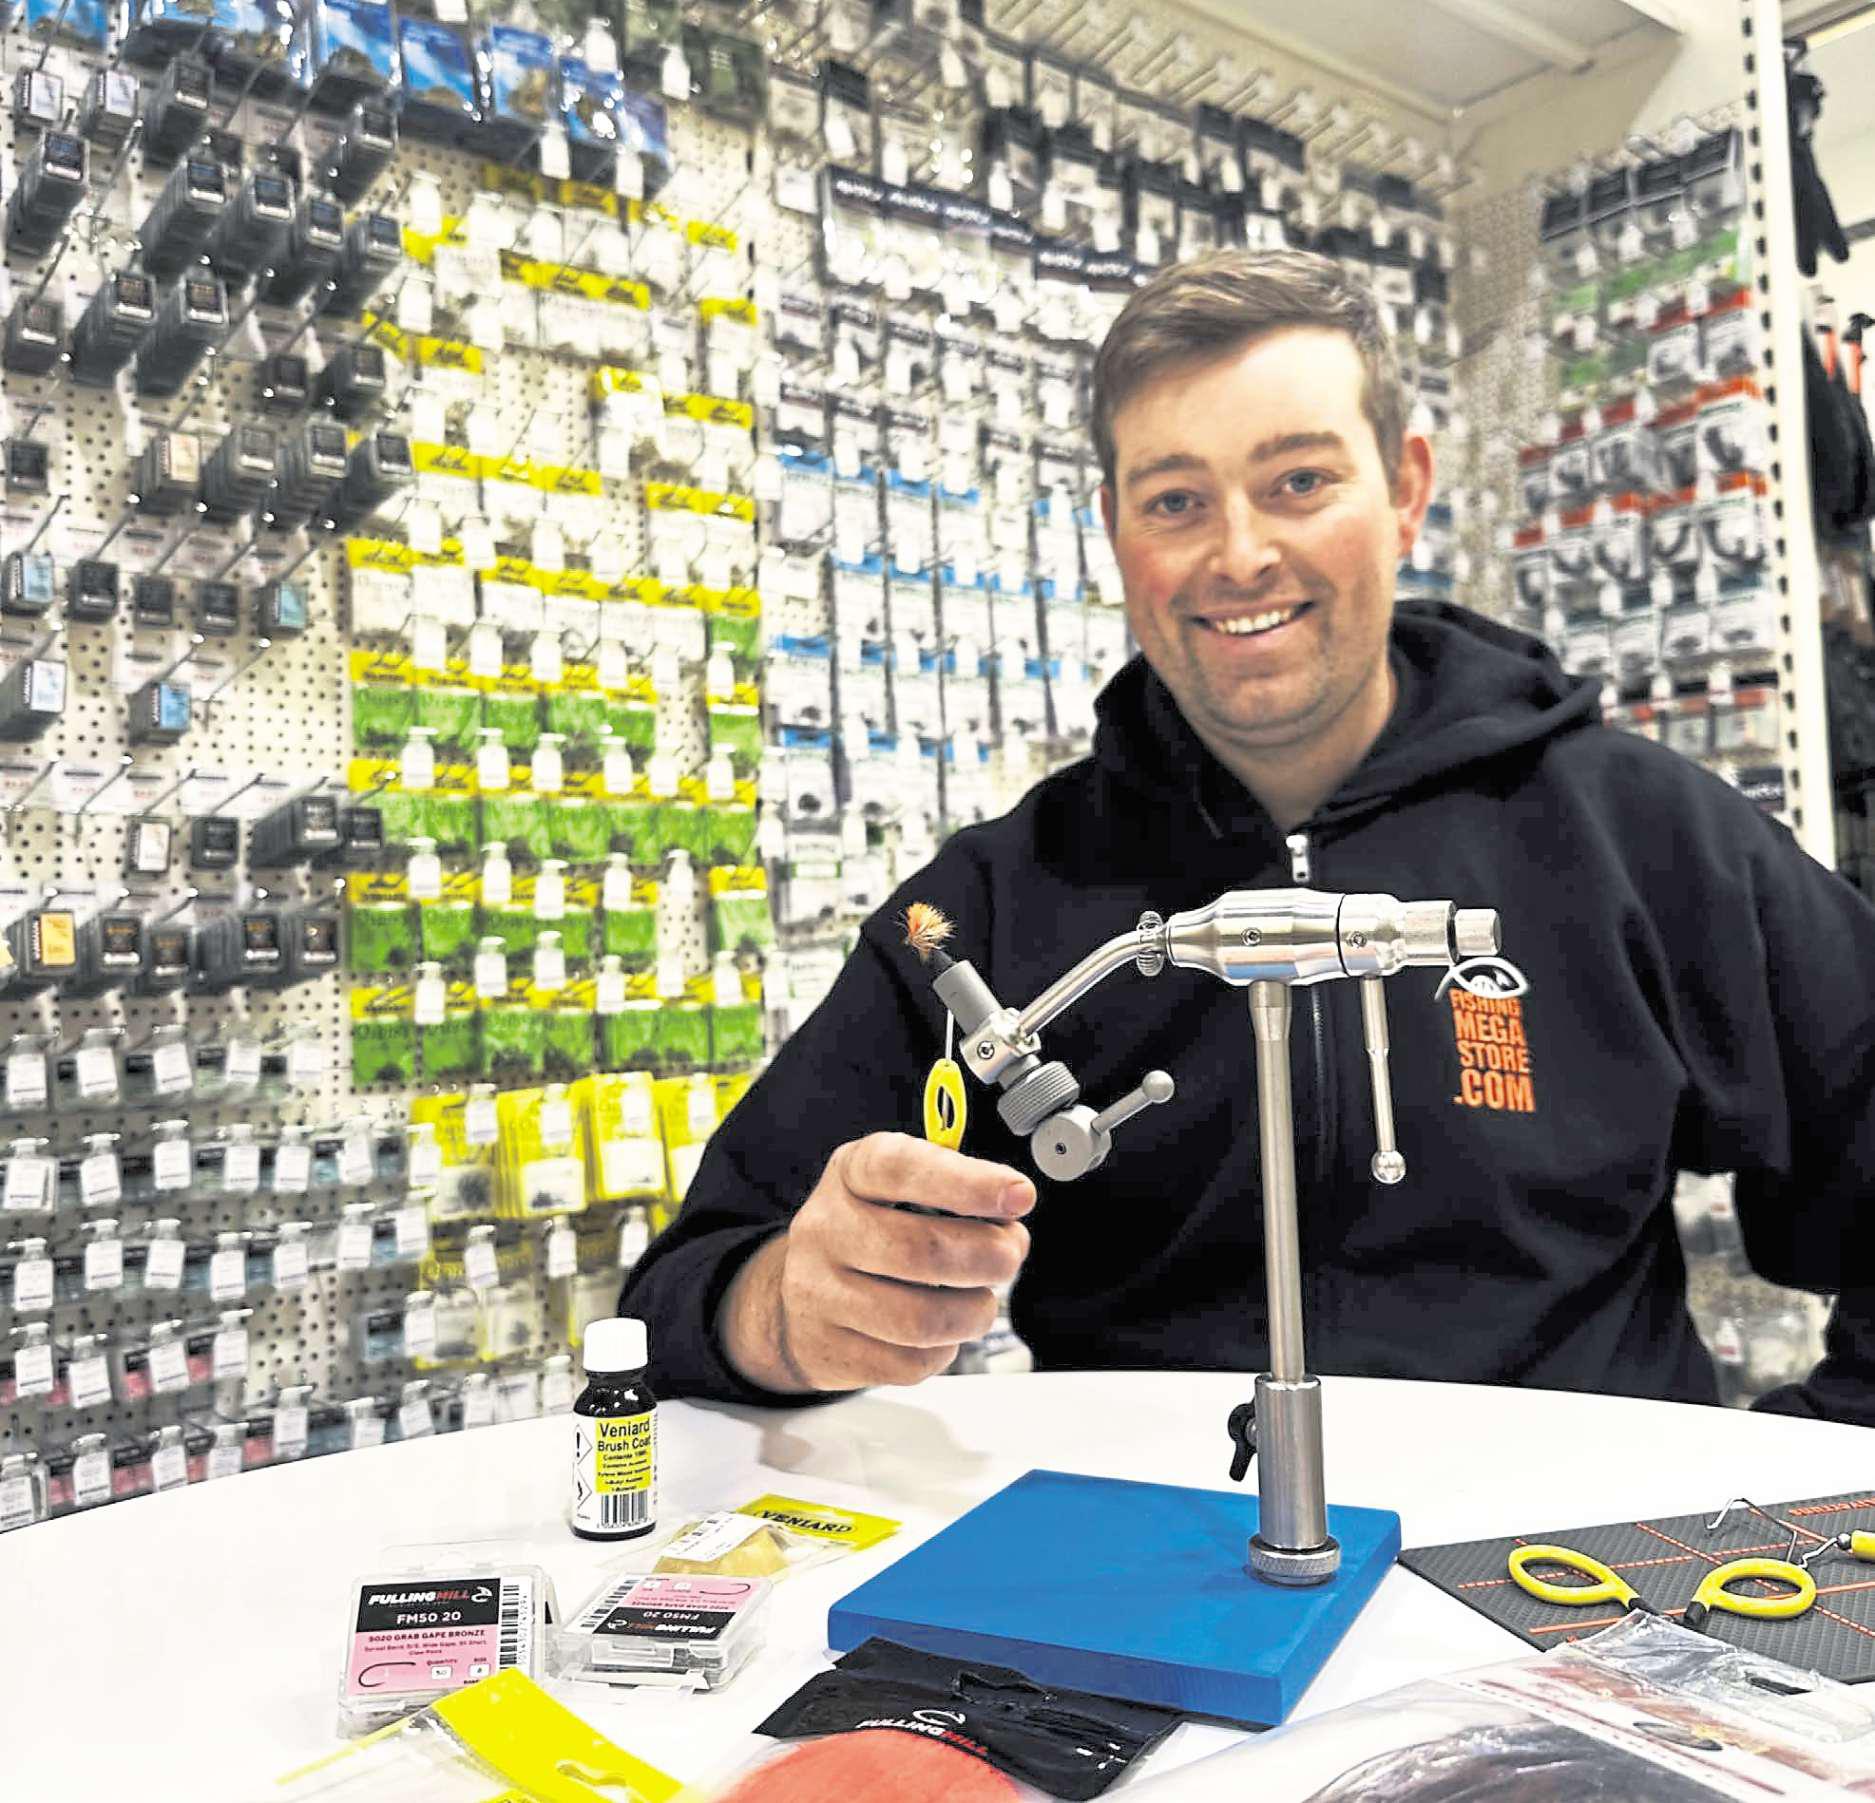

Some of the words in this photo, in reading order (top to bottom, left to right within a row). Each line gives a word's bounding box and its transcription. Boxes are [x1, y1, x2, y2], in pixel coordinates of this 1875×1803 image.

[1454, 1011, 1526, 1046] MEGA
[1456, 1040, 1531, 1073] STORE
[1453, 1069, 1536, 1113] .COM
[600, 1418, 650, 1438] Veniard
[598, 1440, 629, 1452] Brush
[762, 1510, 853, 1533] VENIARD
[397, 1612, 438, 1625] FM50
[441, 1611, 462, 1622] 20
[422, 1631, 446, 1639] GAPE
[448, 1629, 485, 1638] BRONZE
